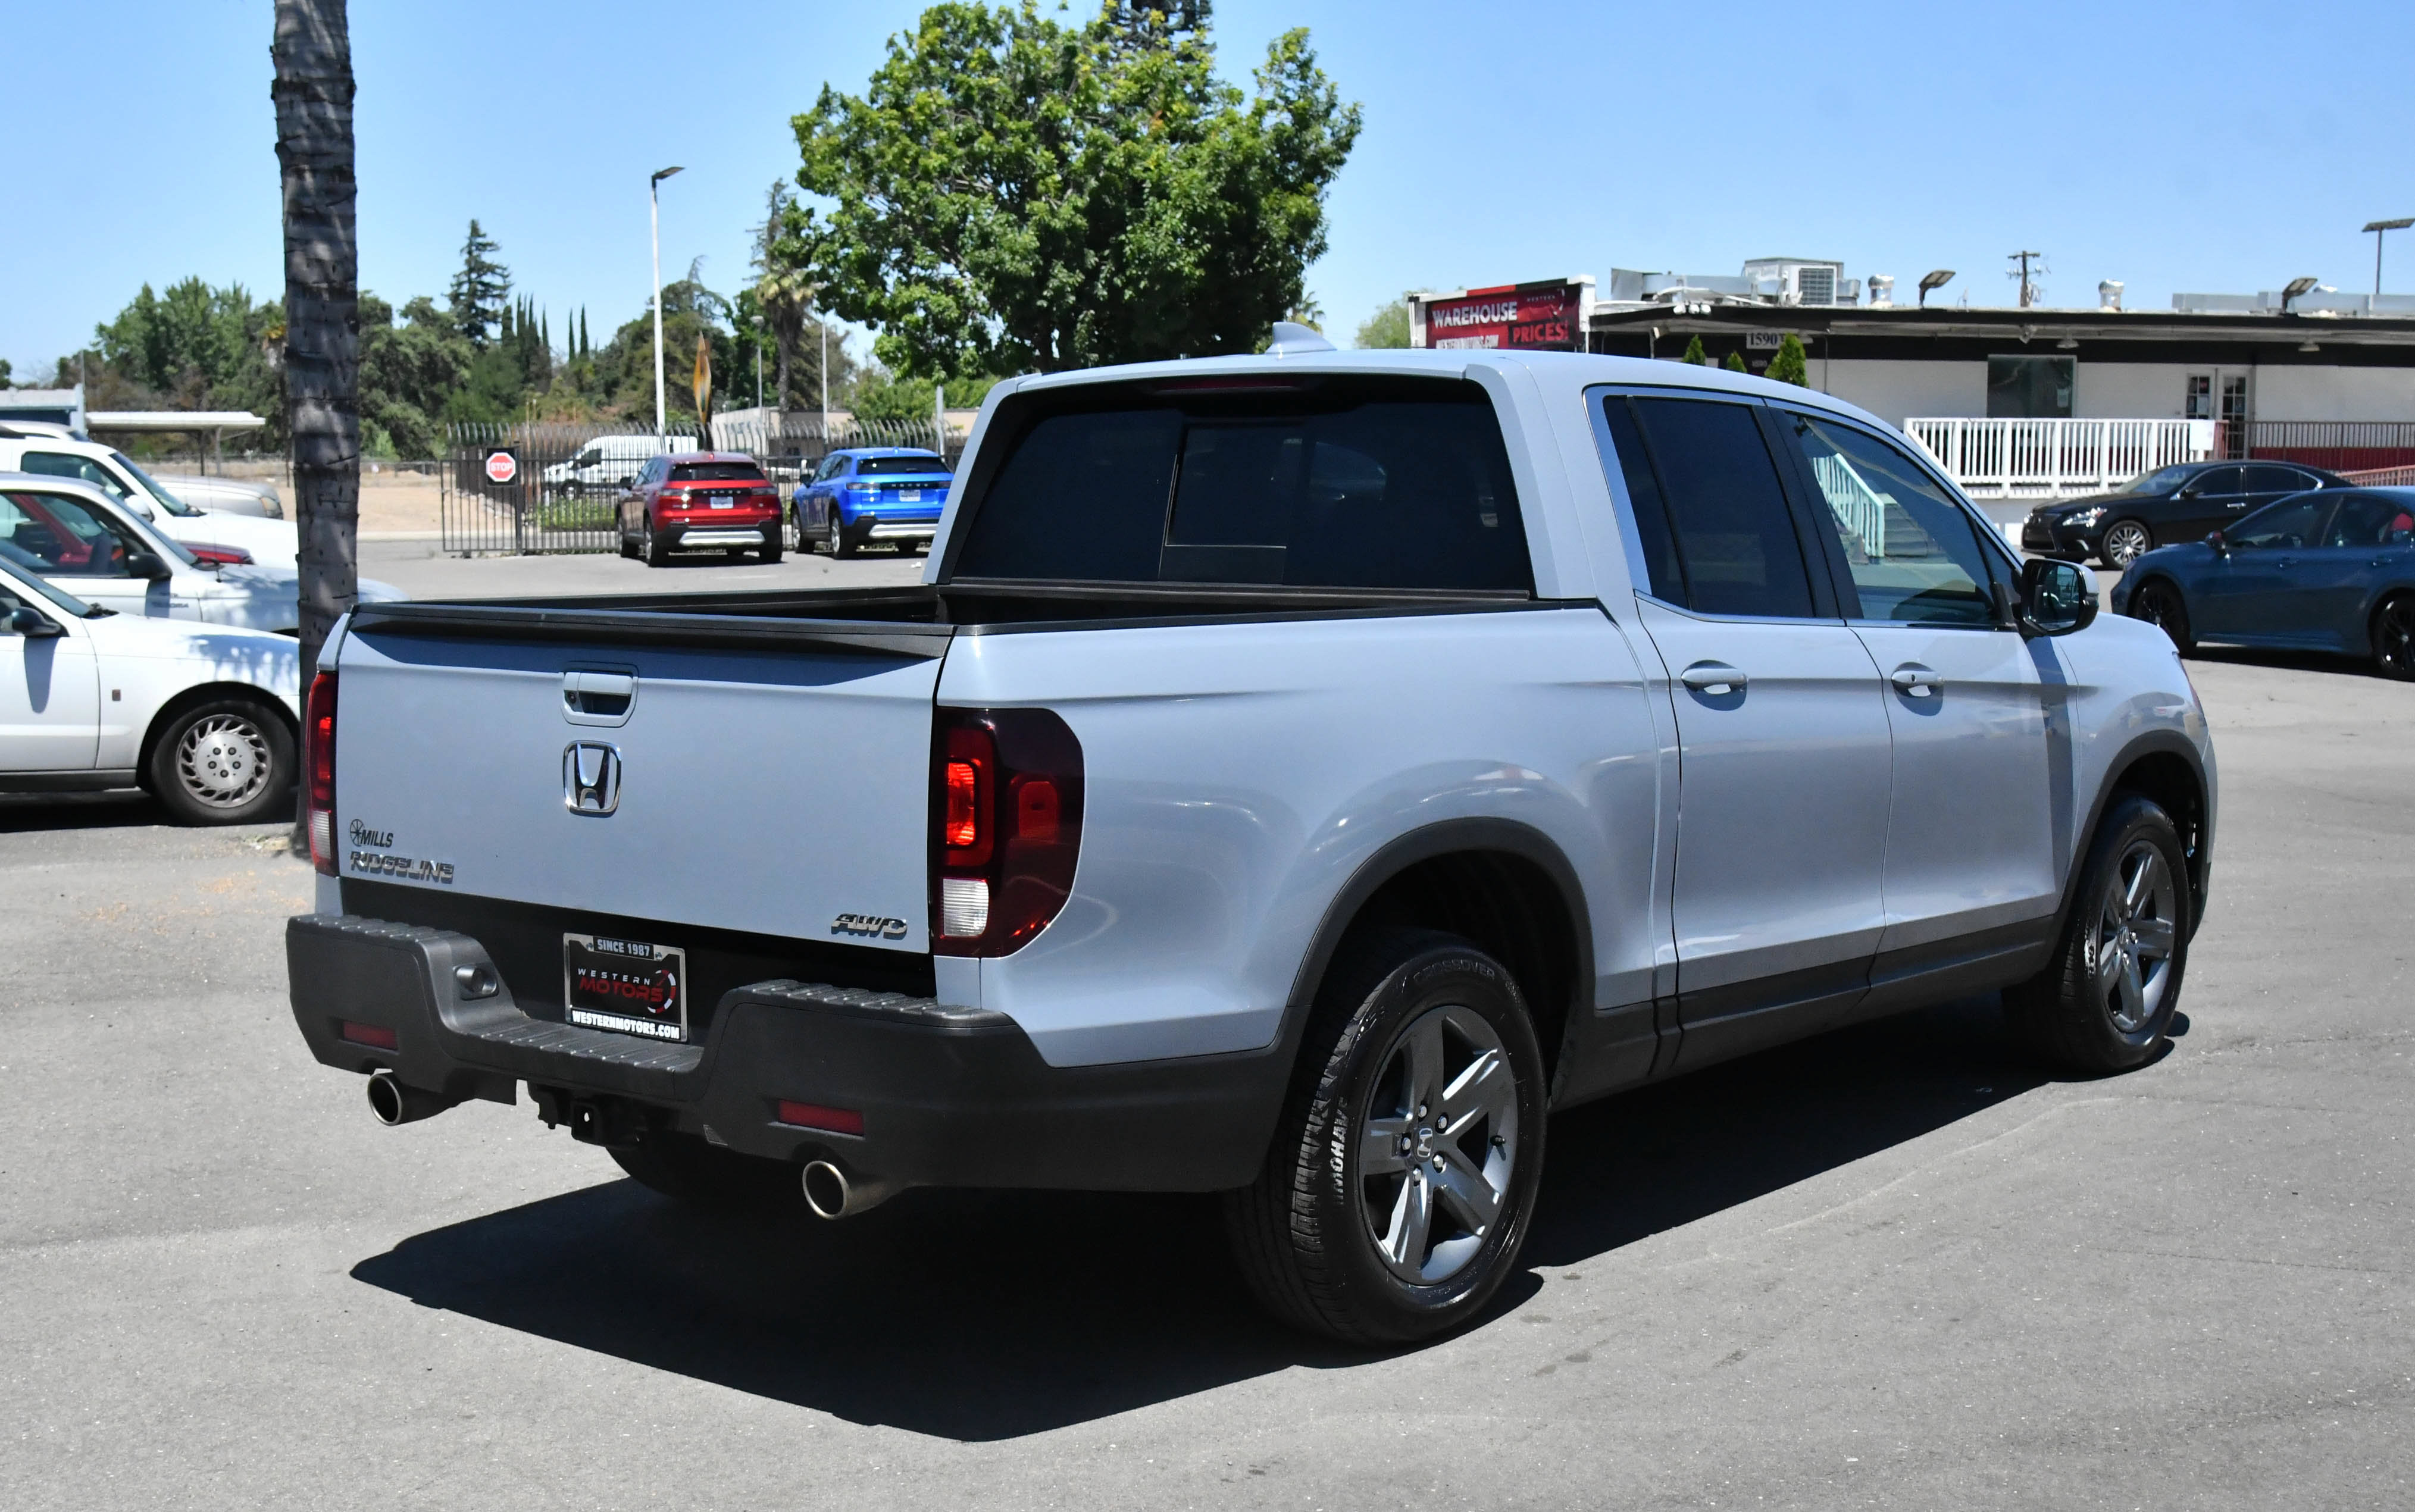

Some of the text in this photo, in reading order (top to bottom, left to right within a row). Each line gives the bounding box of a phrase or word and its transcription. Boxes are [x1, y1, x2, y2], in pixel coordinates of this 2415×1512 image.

[1432, 301, 1517, 328] WAREHOUSE
[1749, 333, 1778, 345] 1590
[490, 462, 512, 472] STOP
[359, 829, 393, 848] MILLS
[350, 851, 454, 882] RIDGELINE
[831, 913, 908, 937] AWD
[597, 938, 650, 957] SINCE 1987
[578, 968, 651, 985] WESTERN
[579, 976, 664, 1003] MOTORS
[571, 1010, 680, 1040] WESTERNMOTORS.COM
